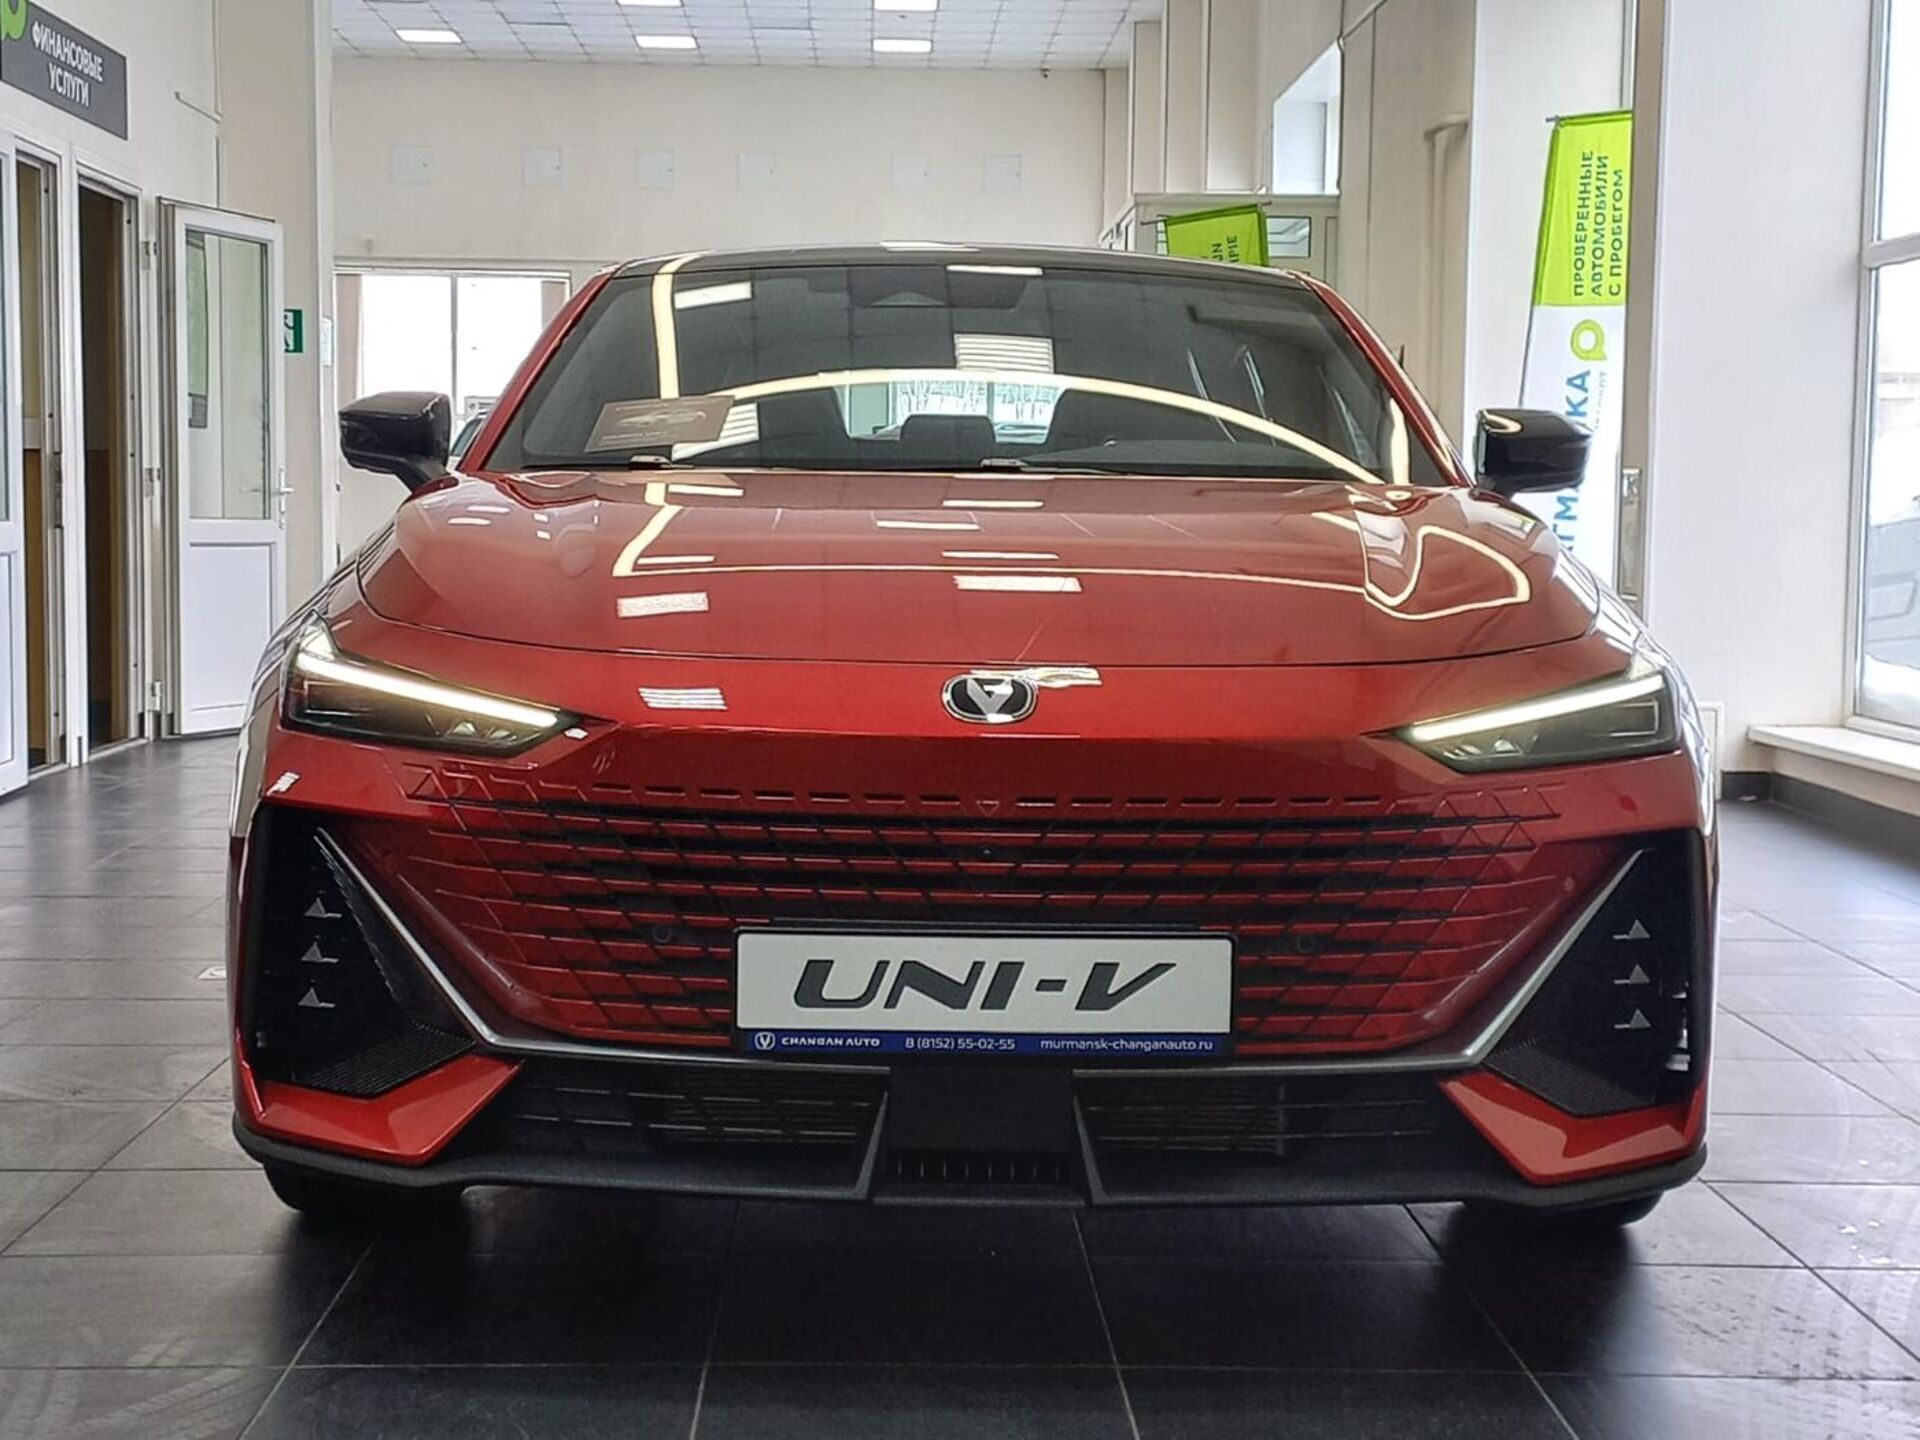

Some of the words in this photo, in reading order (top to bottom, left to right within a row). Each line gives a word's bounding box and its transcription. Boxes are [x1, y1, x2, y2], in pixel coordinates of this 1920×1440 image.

[32, 20, 103, 82] ФИНАНСОВЫЕ
[48, 62, 89, 107] УСЛУГИ
[1573, 150, 1593, 296] ПРОВЕРЕННЫЕ
[1591, 155, 1609, 297] АВТОМОБИЛИ
[1610, 169, 1623, 277] ПРОБЕГОМ
[1609, 283, 1622, 296] С
[793, 959, 1177, 1011] UNI-V
[781, 1036, 844, 1047] CHANGAN
[846, 1037, 880, 1047] AUTO
[905, 1037, 914, 1049] 8
[916, 1036, 955, 1051] (8152)
[957, 1038, 1015, 1050] 55-02-55
[1040, 1038, 1214, 1053] murmansk-changanauto.ru
